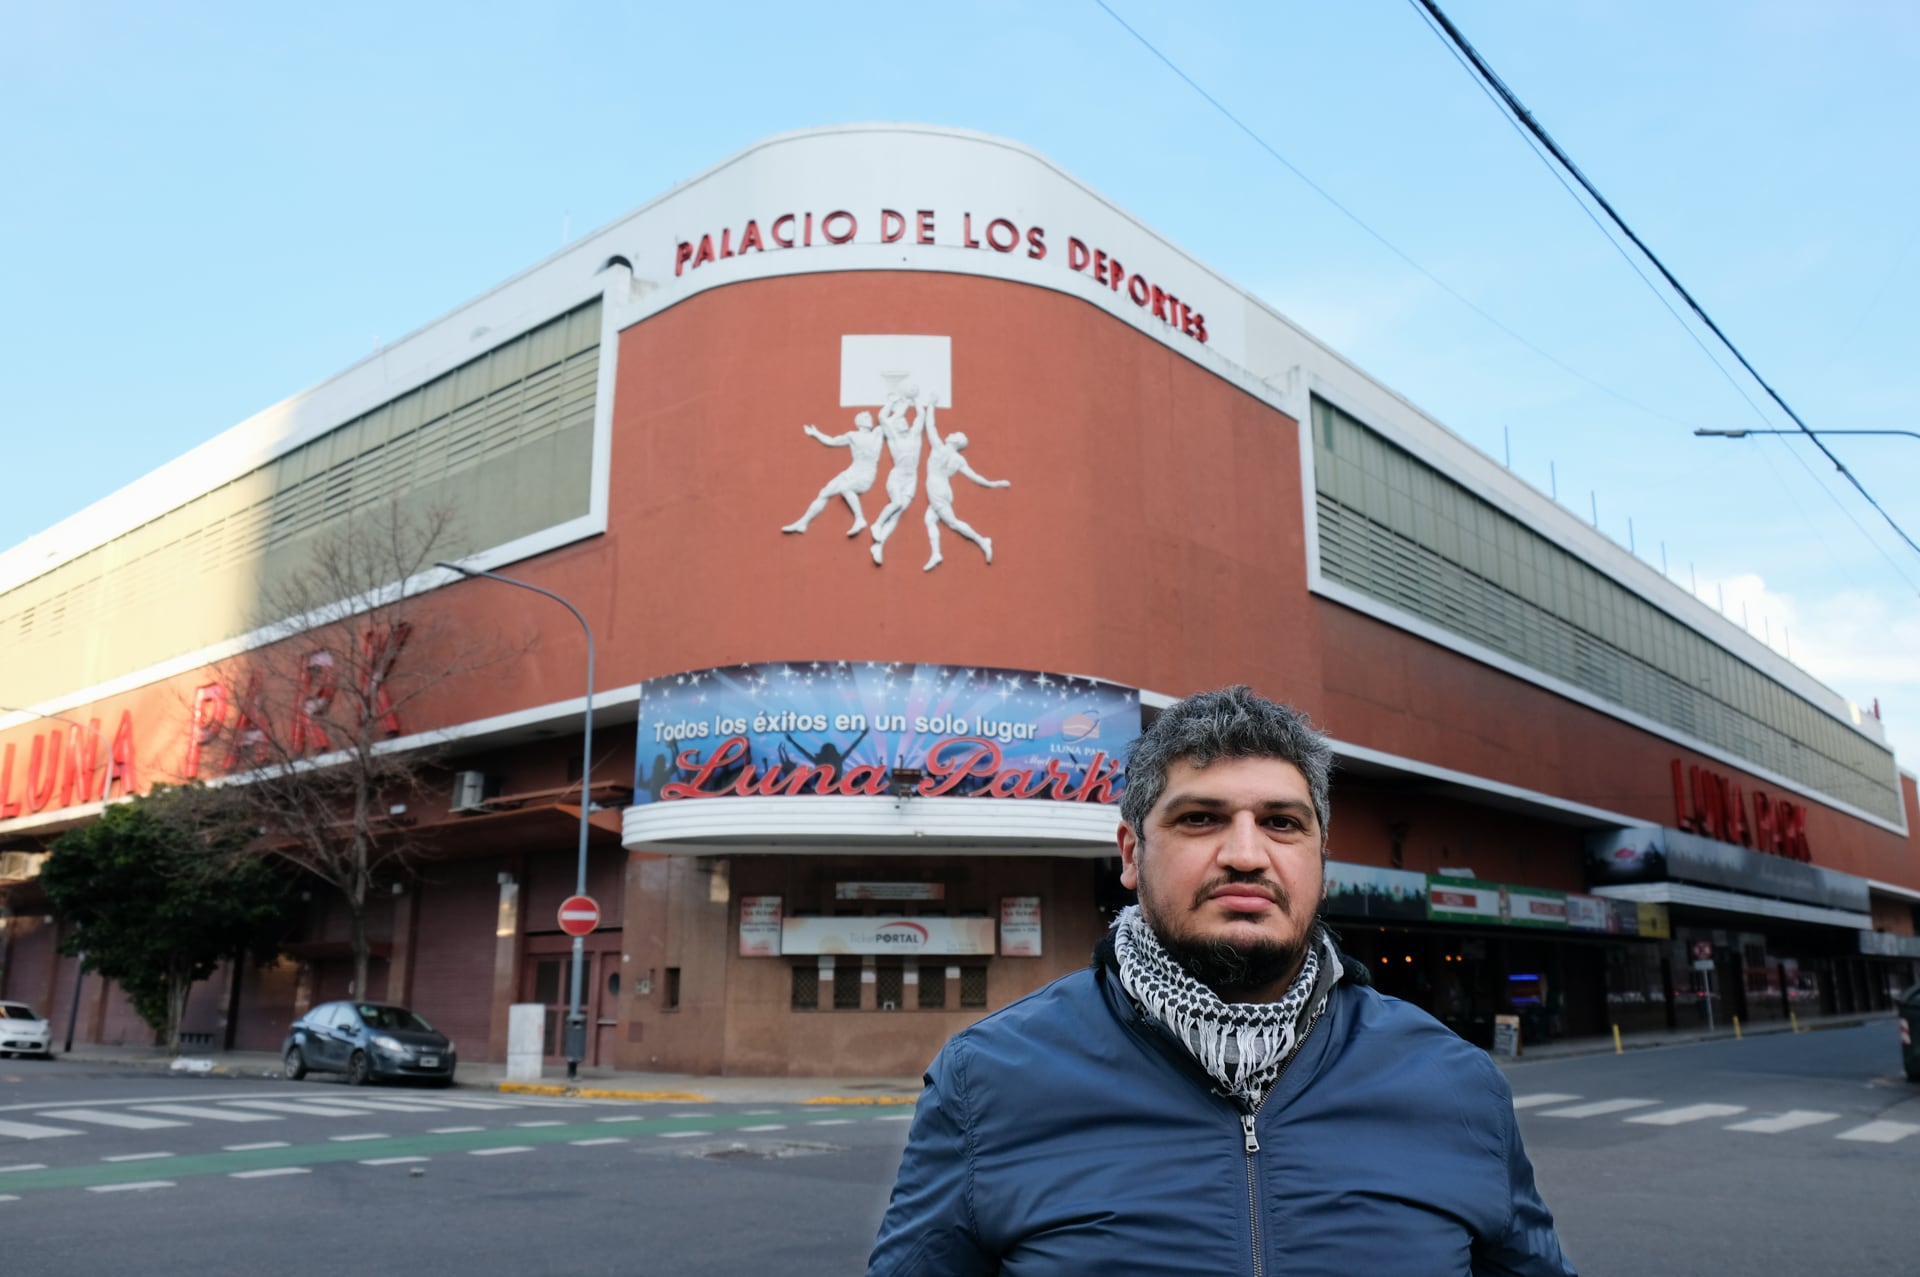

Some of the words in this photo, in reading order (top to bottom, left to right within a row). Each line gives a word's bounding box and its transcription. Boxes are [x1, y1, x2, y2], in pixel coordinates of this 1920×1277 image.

[674, 210, 858, 277] PALACIO
[881, 208, 935, 245] DE
[963, 212, 1047, 260] LOS
[1067, 235, 1208, 344] DEPORTES
[0, 709, 137, 819] LUNA
[185, 621, 412, 779] PARK
[653, 720, 709, 742] Todos
[715, 715, 747, 736] los
[753, 711, 827, 733] éxitos
[834, 713, 867, 732] en
[875, 714, 907, 732] un
[914, 714, 969, 736] solo
[976, 715, 1038, 743] lugar
[1050, 743, 1081, 756] LUNA
[661, 736, 890, 800] Luna
[917, 736, 1125, 803] Park
[1671, 758, 1753, 848] LUNA
[1753, 791, 1812, 864] PARK
